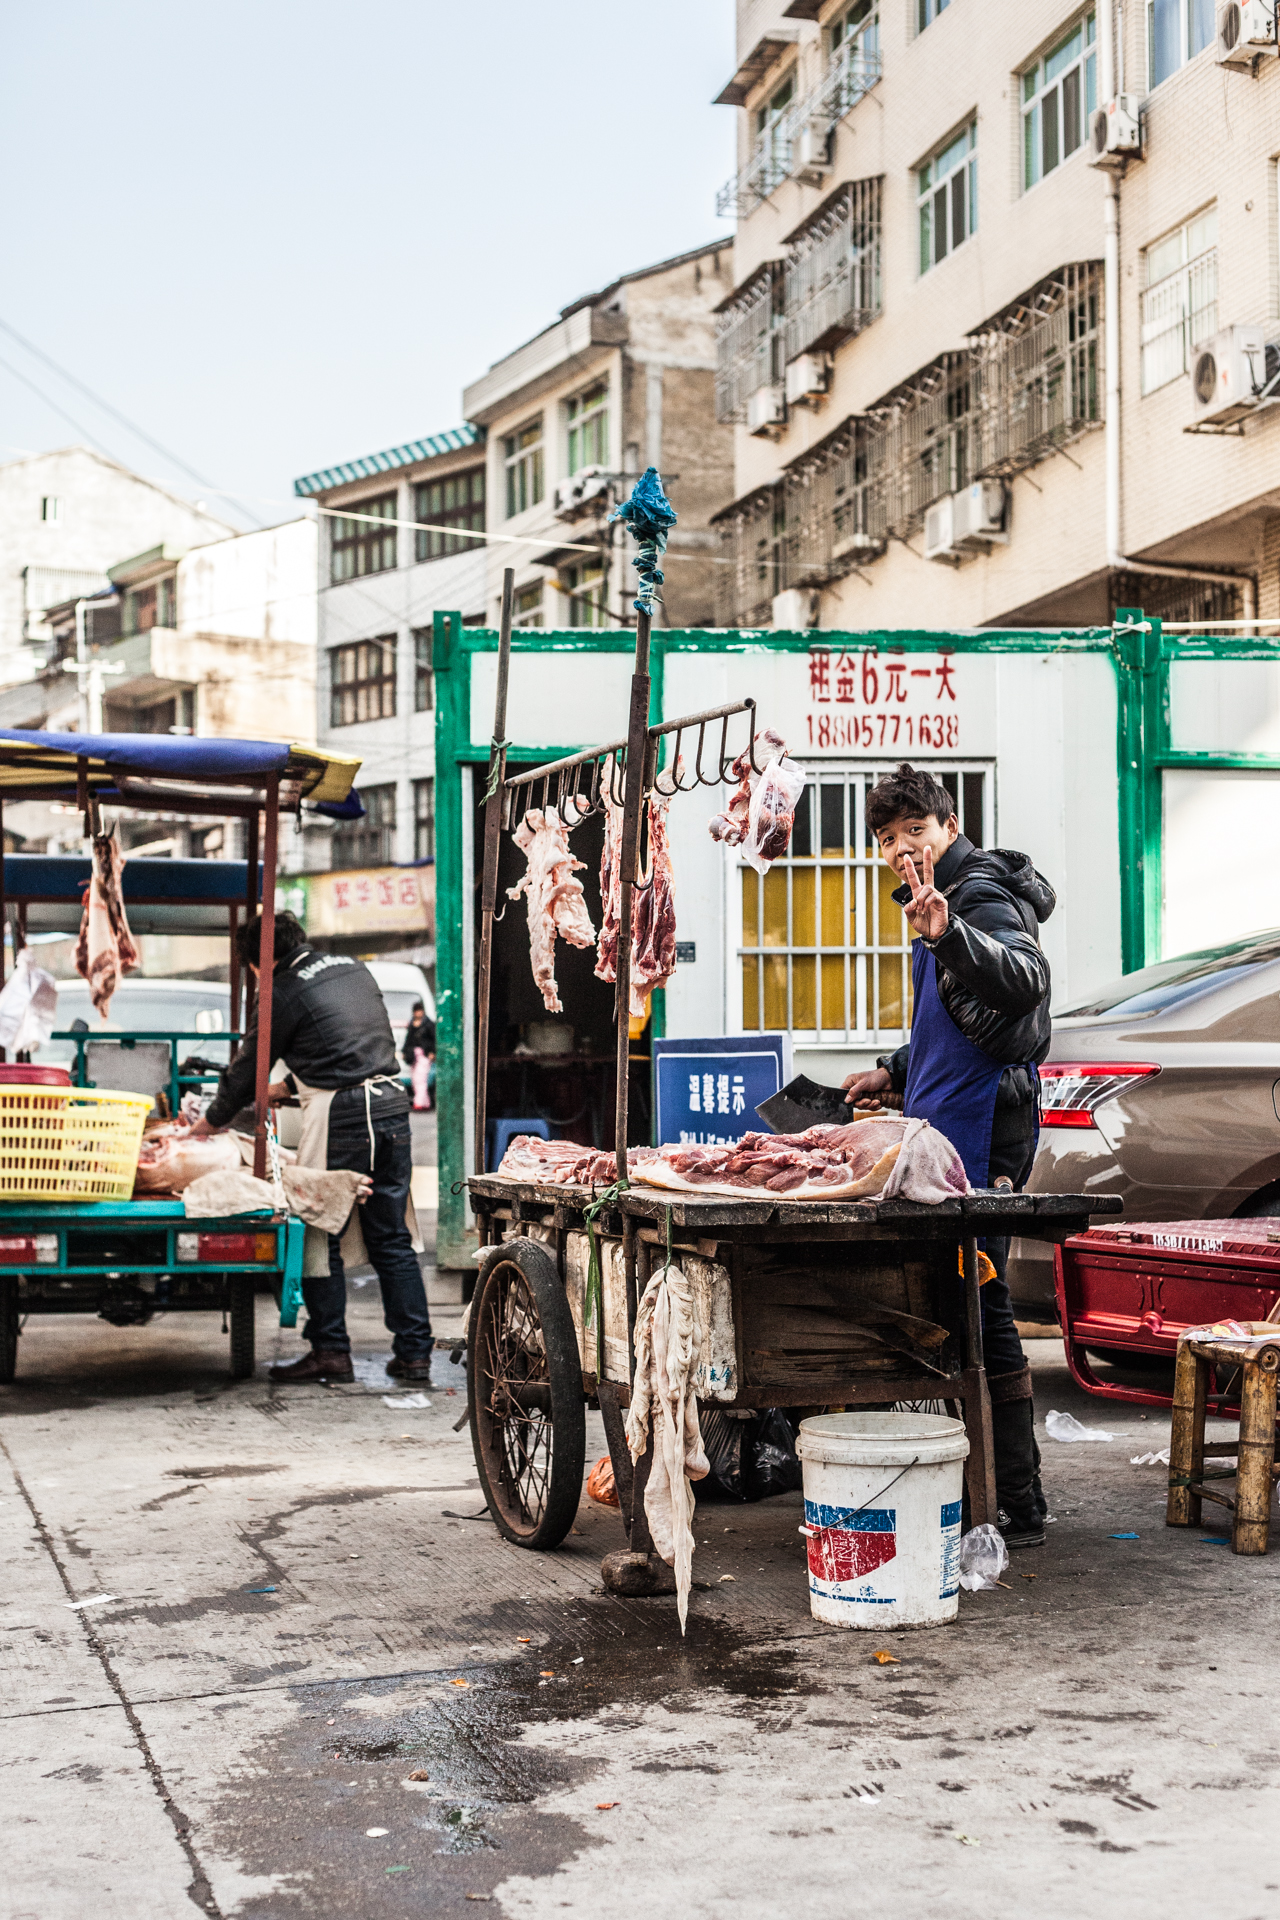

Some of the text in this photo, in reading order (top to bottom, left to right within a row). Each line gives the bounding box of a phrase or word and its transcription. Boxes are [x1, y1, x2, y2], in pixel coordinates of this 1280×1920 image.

[808, 645, 957, 704] 租金6元一天
[807, 714, 958, 748] 18805771638
[689, 1073, 746, 1116] 温馨提示
